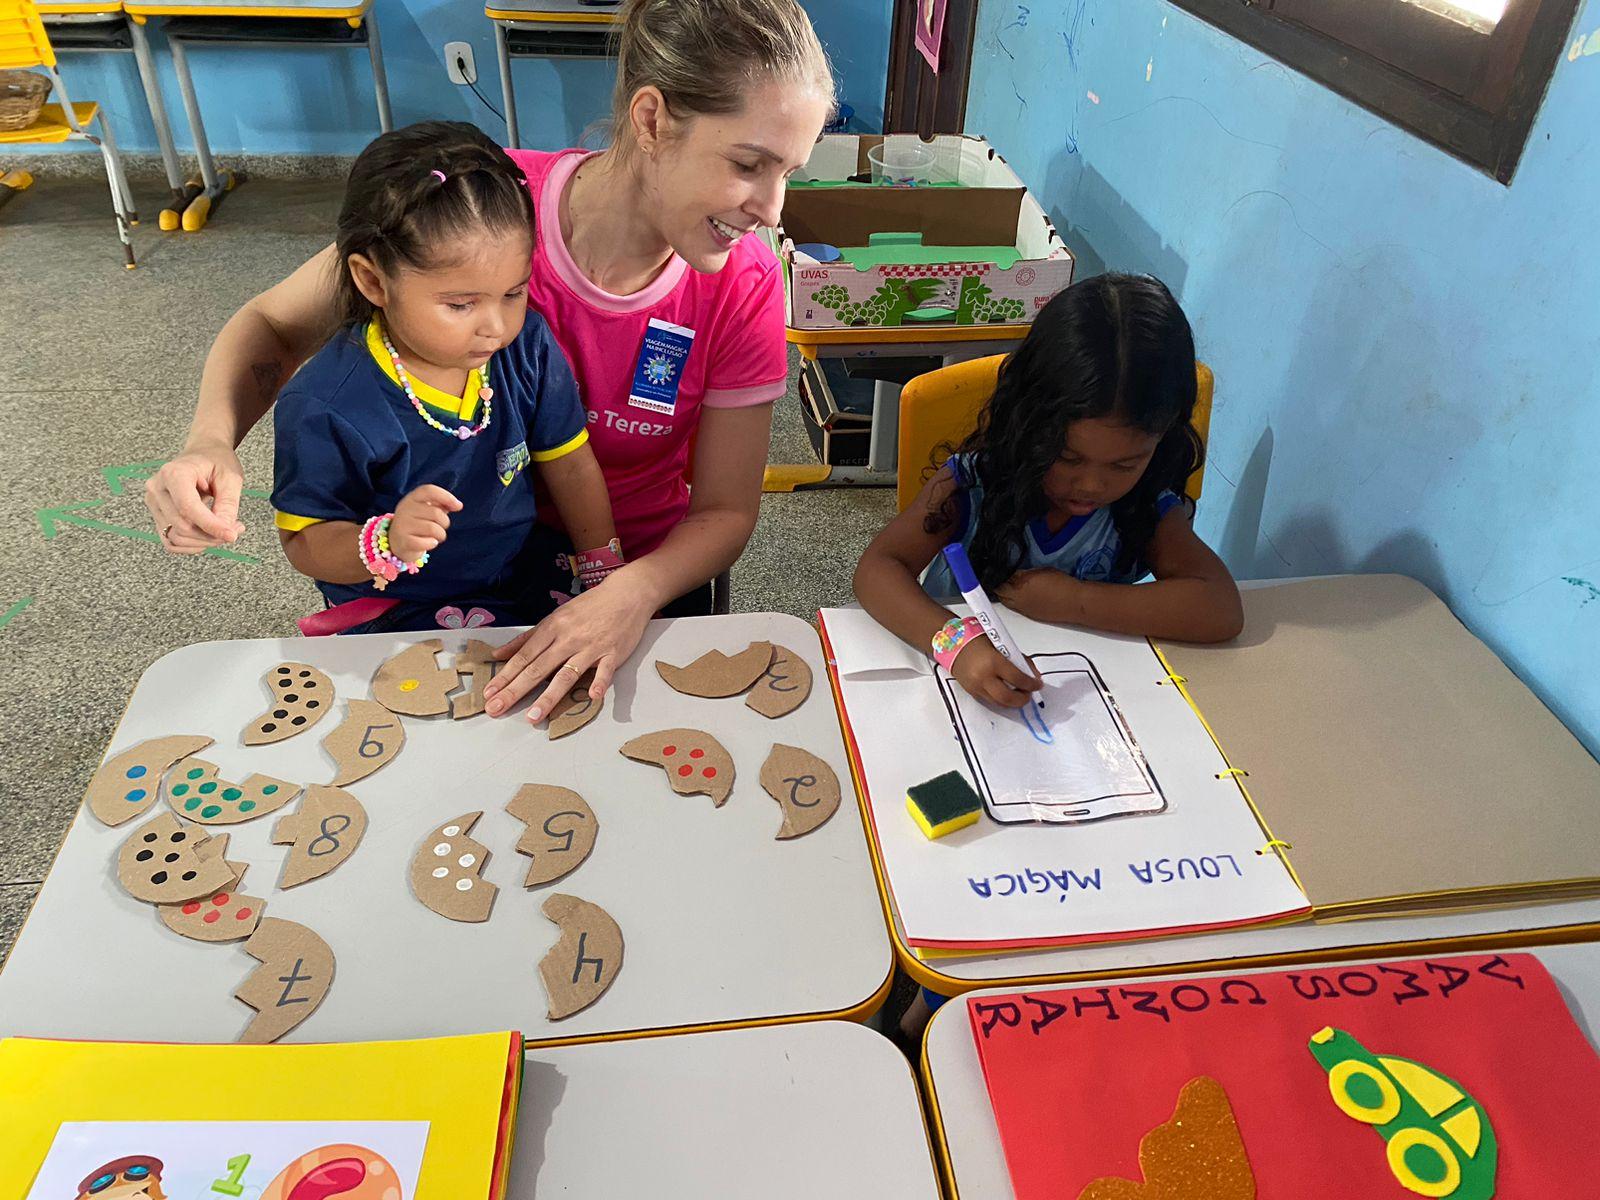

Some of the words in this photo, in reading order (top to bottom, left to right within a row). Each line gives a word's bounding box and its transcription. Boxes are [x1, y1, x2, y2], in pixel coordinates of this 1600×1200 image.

[800, 269, 829, 279] UVAS
[604, 409, 673, 436] Tereza
[767, 659, 799, 692] 3
[782, 774, 821, 808] 2
[308, 814, 351, 858] 8
[543, 810, 586, 853] 5
[968, 868, 1102, 904] MÁGICA
[1128, 854, 1243, 885] LOUSA
[572, 932, 604, 985] 4
[276, 958, 313, 1008] 7
[1286, 955, 1526, 1006] VAMOS
[975, 979, 1268, 1039] CONTAR
[210, 1153, 252, 1198] 1
